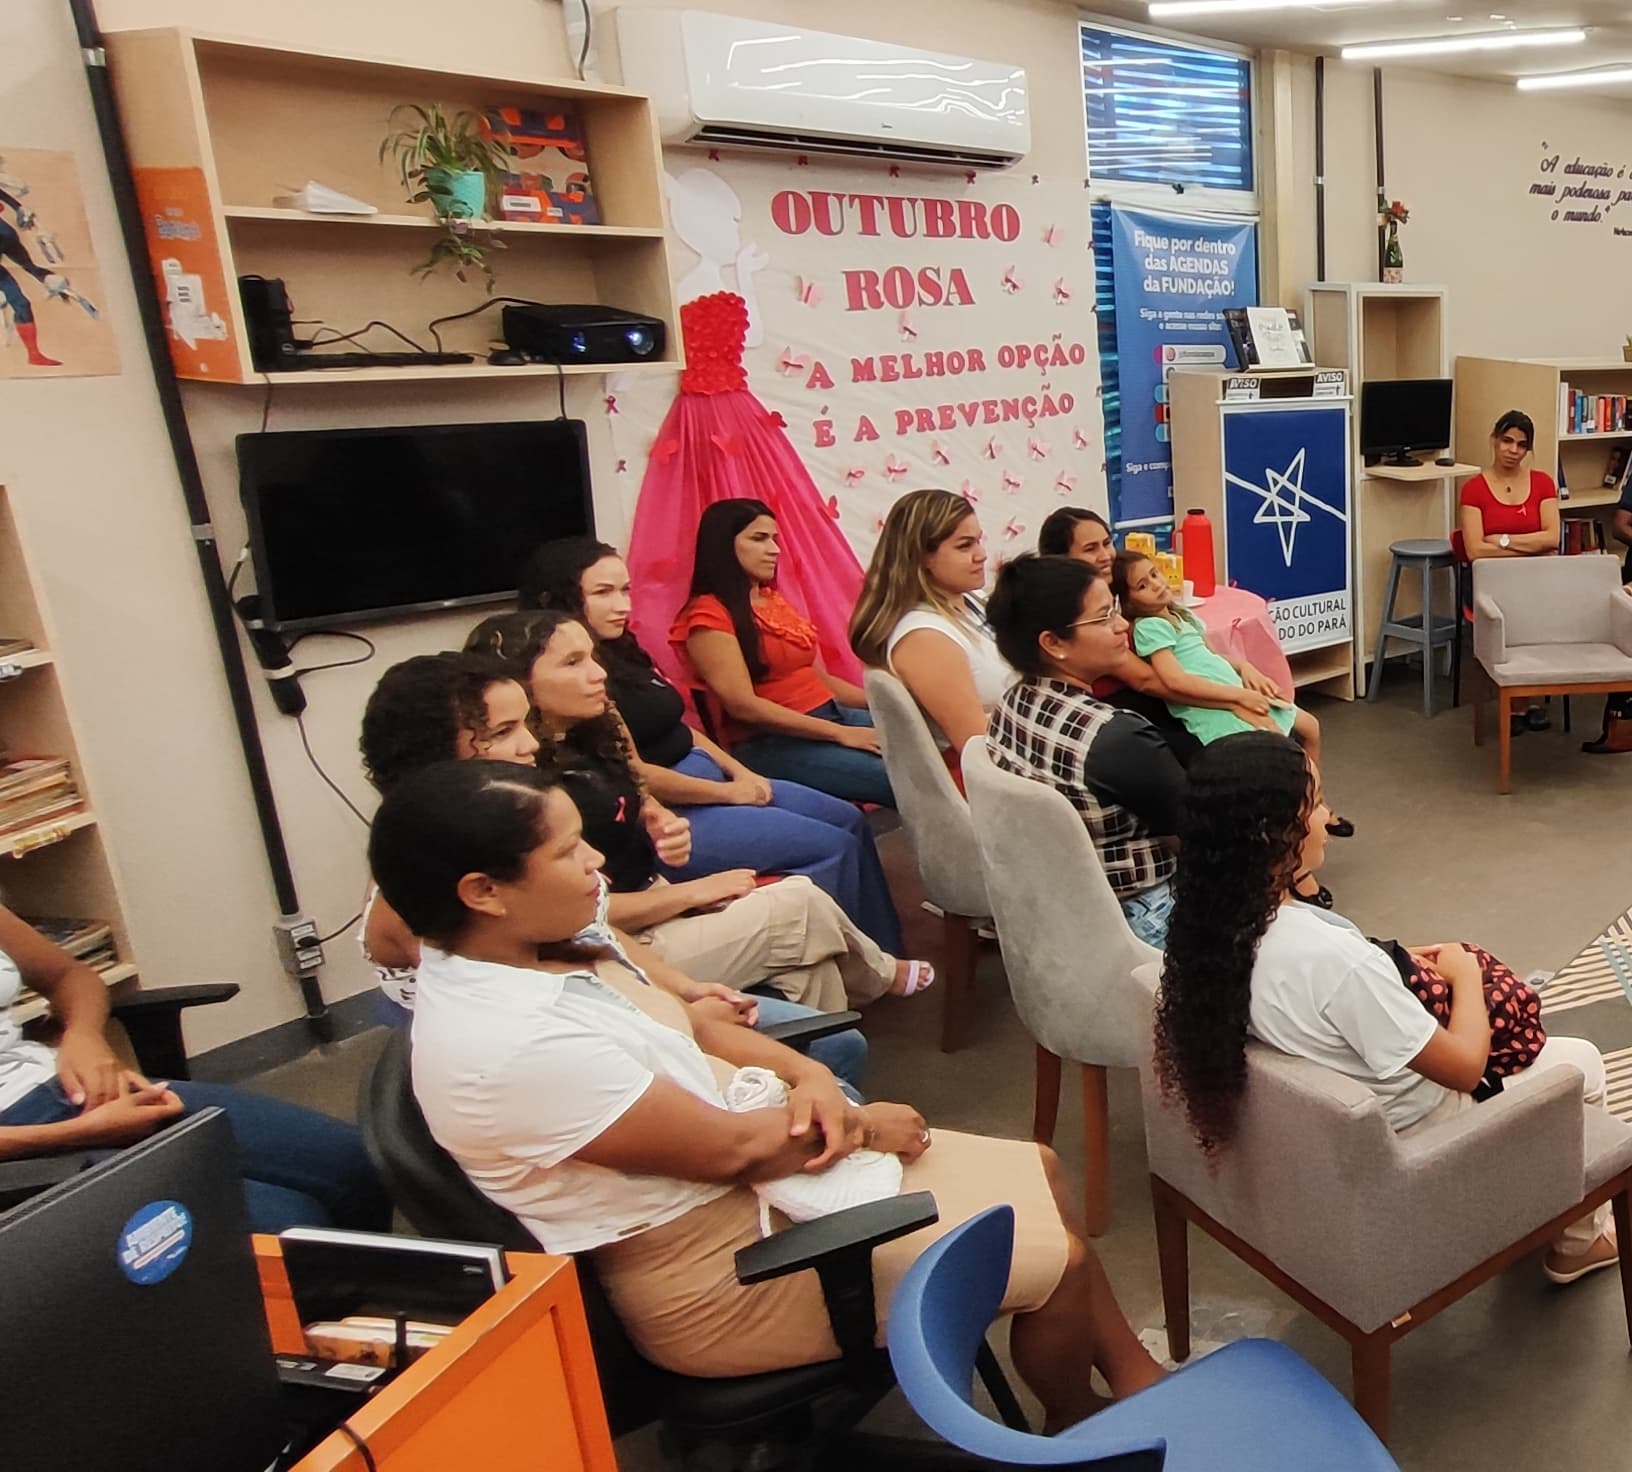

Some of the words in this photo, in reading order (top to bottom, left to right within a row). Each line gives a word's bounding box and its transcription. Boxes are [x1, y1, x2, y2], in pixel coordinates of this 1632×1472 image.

[770, 190, 1021, 242] OUTUBRO
[1134, 230, 1169, 252] Fique
[1171, 237, 1194, 254] por
[1194, 236, 1236, 256] dentro
[1144, 253, 1167, 272] das
[1169, 255, 1229, 275] AGENDAS
[841, 266, 976, 312] ROSA
[1143, 275, 1160, 293] da
[1161, 276, 1235, 299] FUNDAÇÃO!
[805, 361, 834, 389] A
[850, 346, 986, 383] MELHOR
[997, 334, 1086, 375] OPÇÃO
[1229, 377, 1258, 389] AVISO
[1316, 371, 1344, 384] AVISO
[812, 405, 835, 448] É
[854, 415, 879, 442] A
[895, 384, 1075, 436] PREVENÇÃO
[1292, 598, 1346, 619] CULTURAL
[1298, 622, 1315, 637] DO
[1317, 613, 1347, 633] PARÁ
